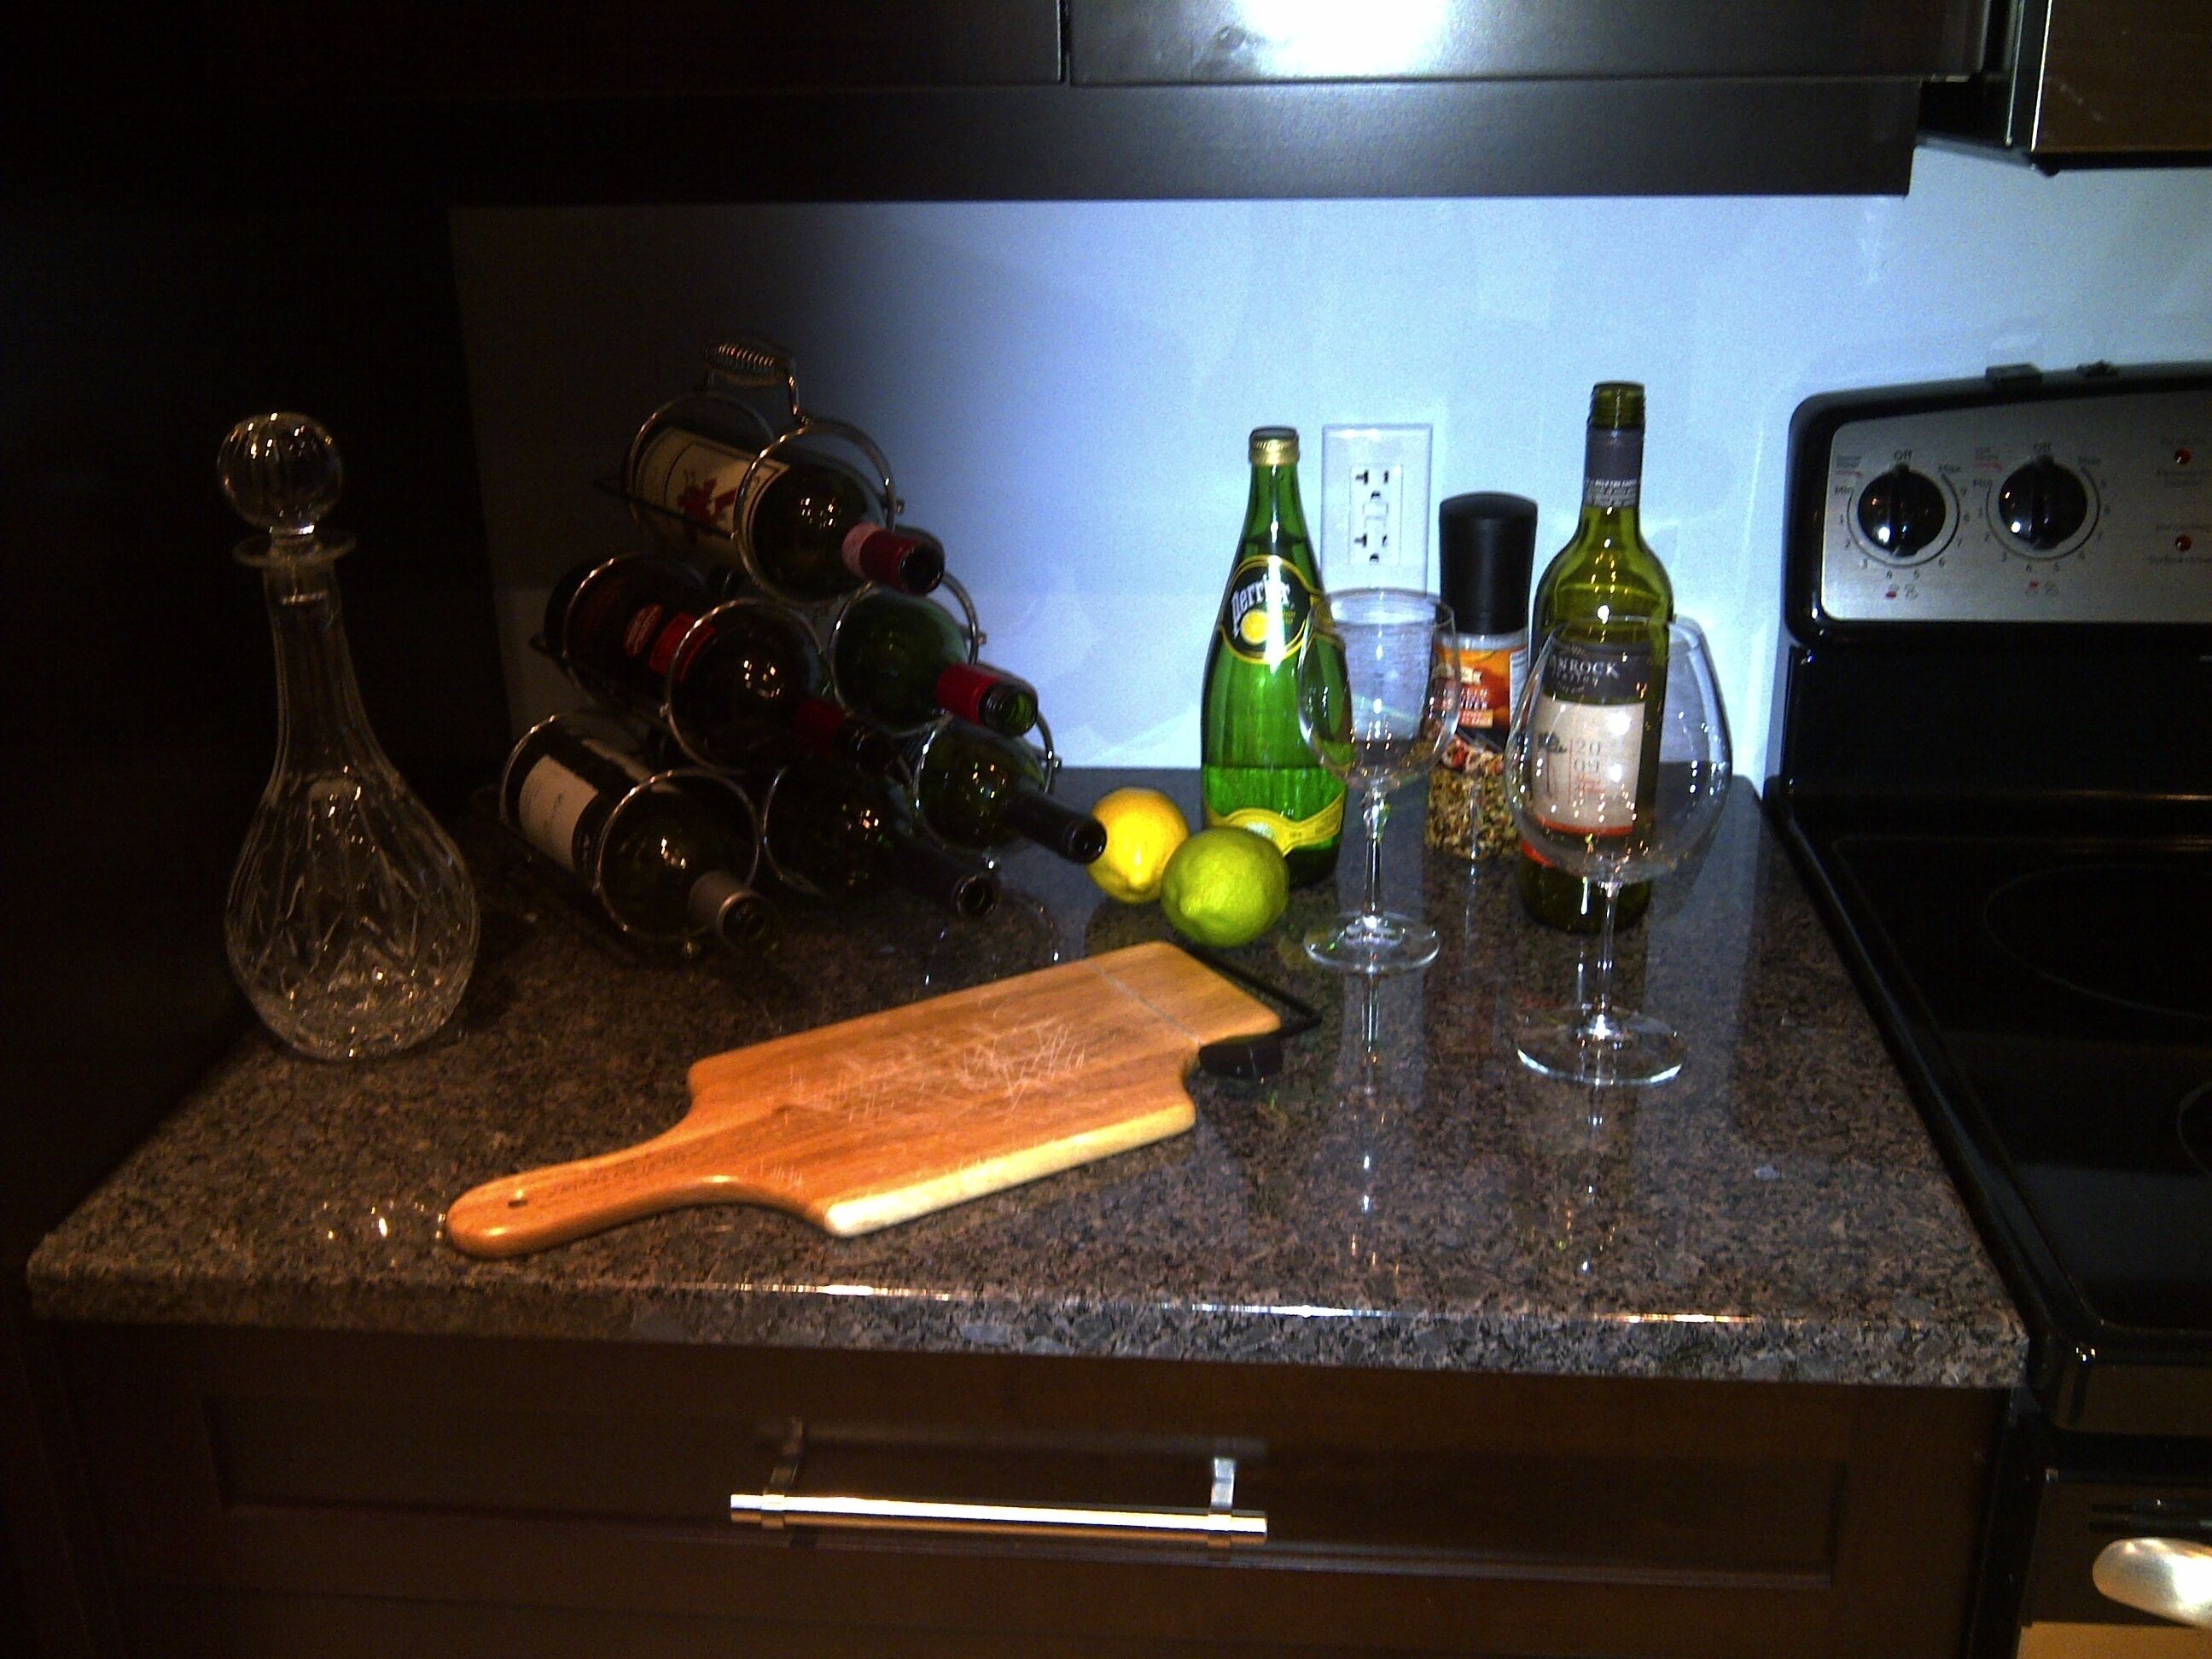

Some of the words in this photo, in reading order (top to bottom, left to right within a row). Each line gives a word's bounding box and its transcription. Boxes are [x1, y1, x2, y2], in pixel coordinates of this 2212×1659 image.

[1894, 449, 1912, 461] Off
[1231, 573, 1291, 639] Perrir
[1548, 654, 1620, 680] ANROCK
